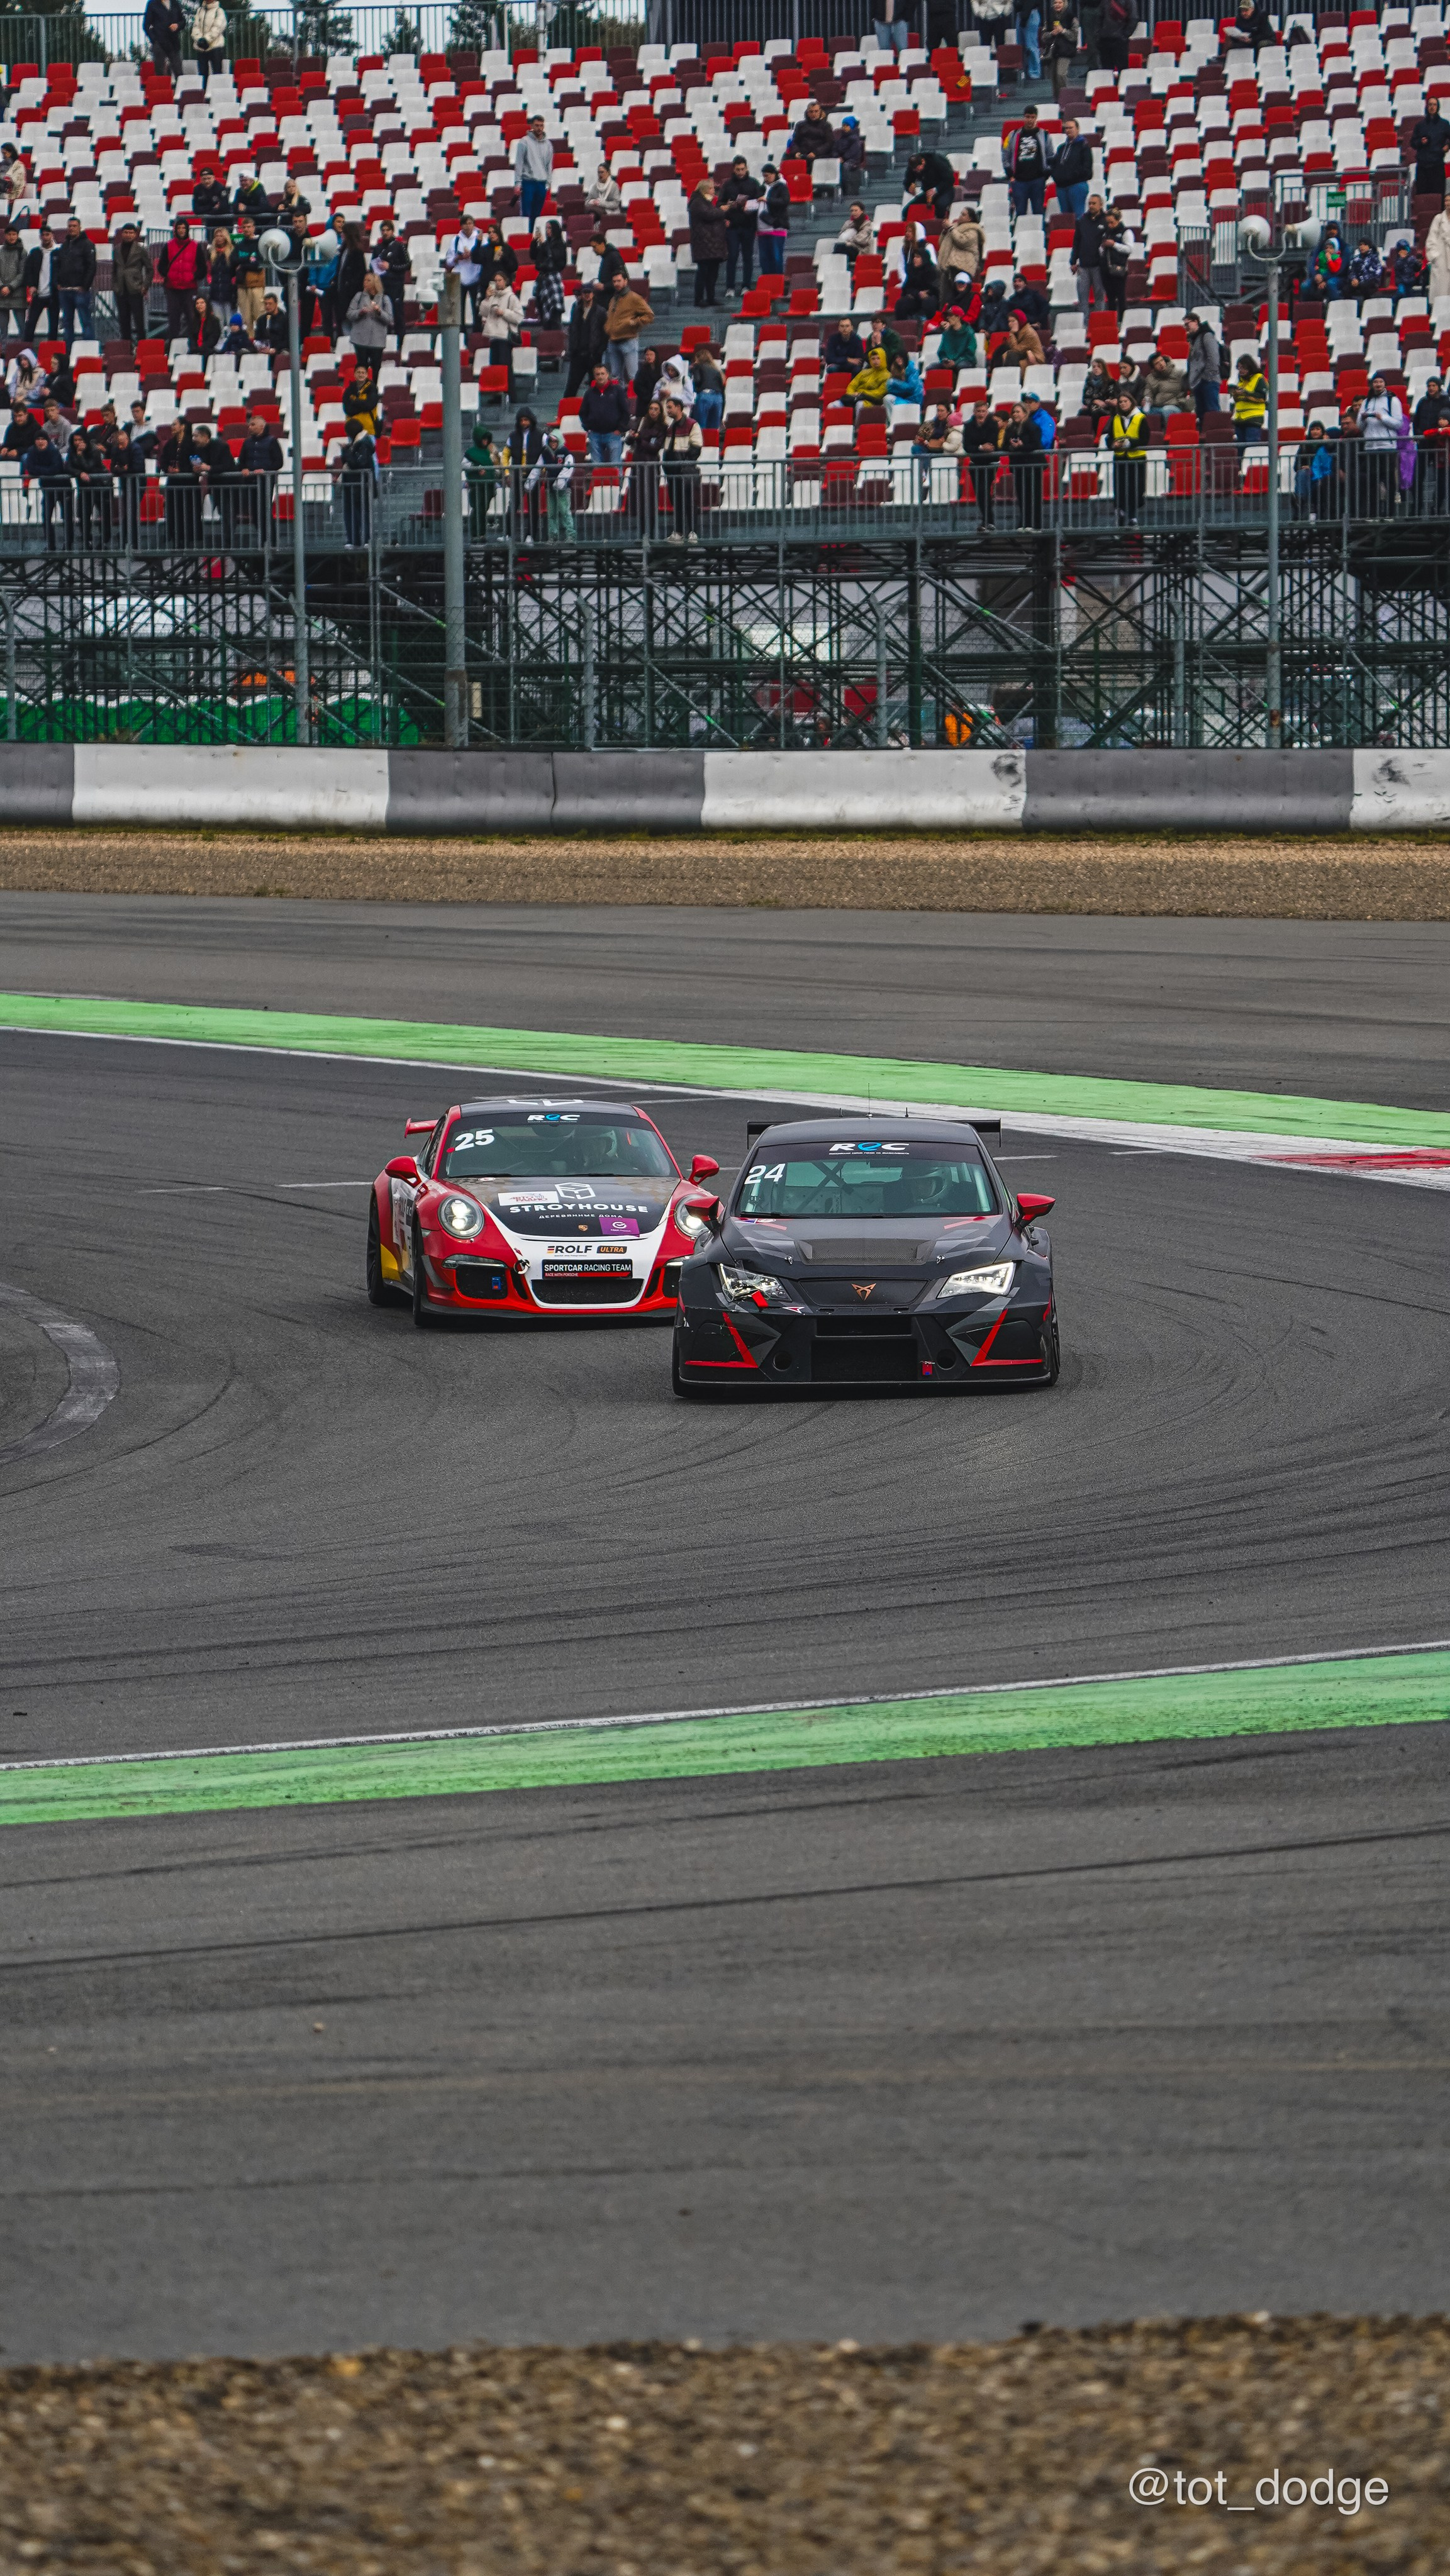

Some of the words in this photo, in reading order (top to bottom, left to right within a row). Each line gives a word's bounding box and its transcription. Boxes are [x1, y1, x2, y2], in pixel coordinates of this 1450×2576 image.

[455, 1129, 495, 1152] 25
[744, 1163, 786, 1185] 24
[510, 1203, 649, 1213] STROYHOUSE
[555, 1245, 593, 1253] ROLF
